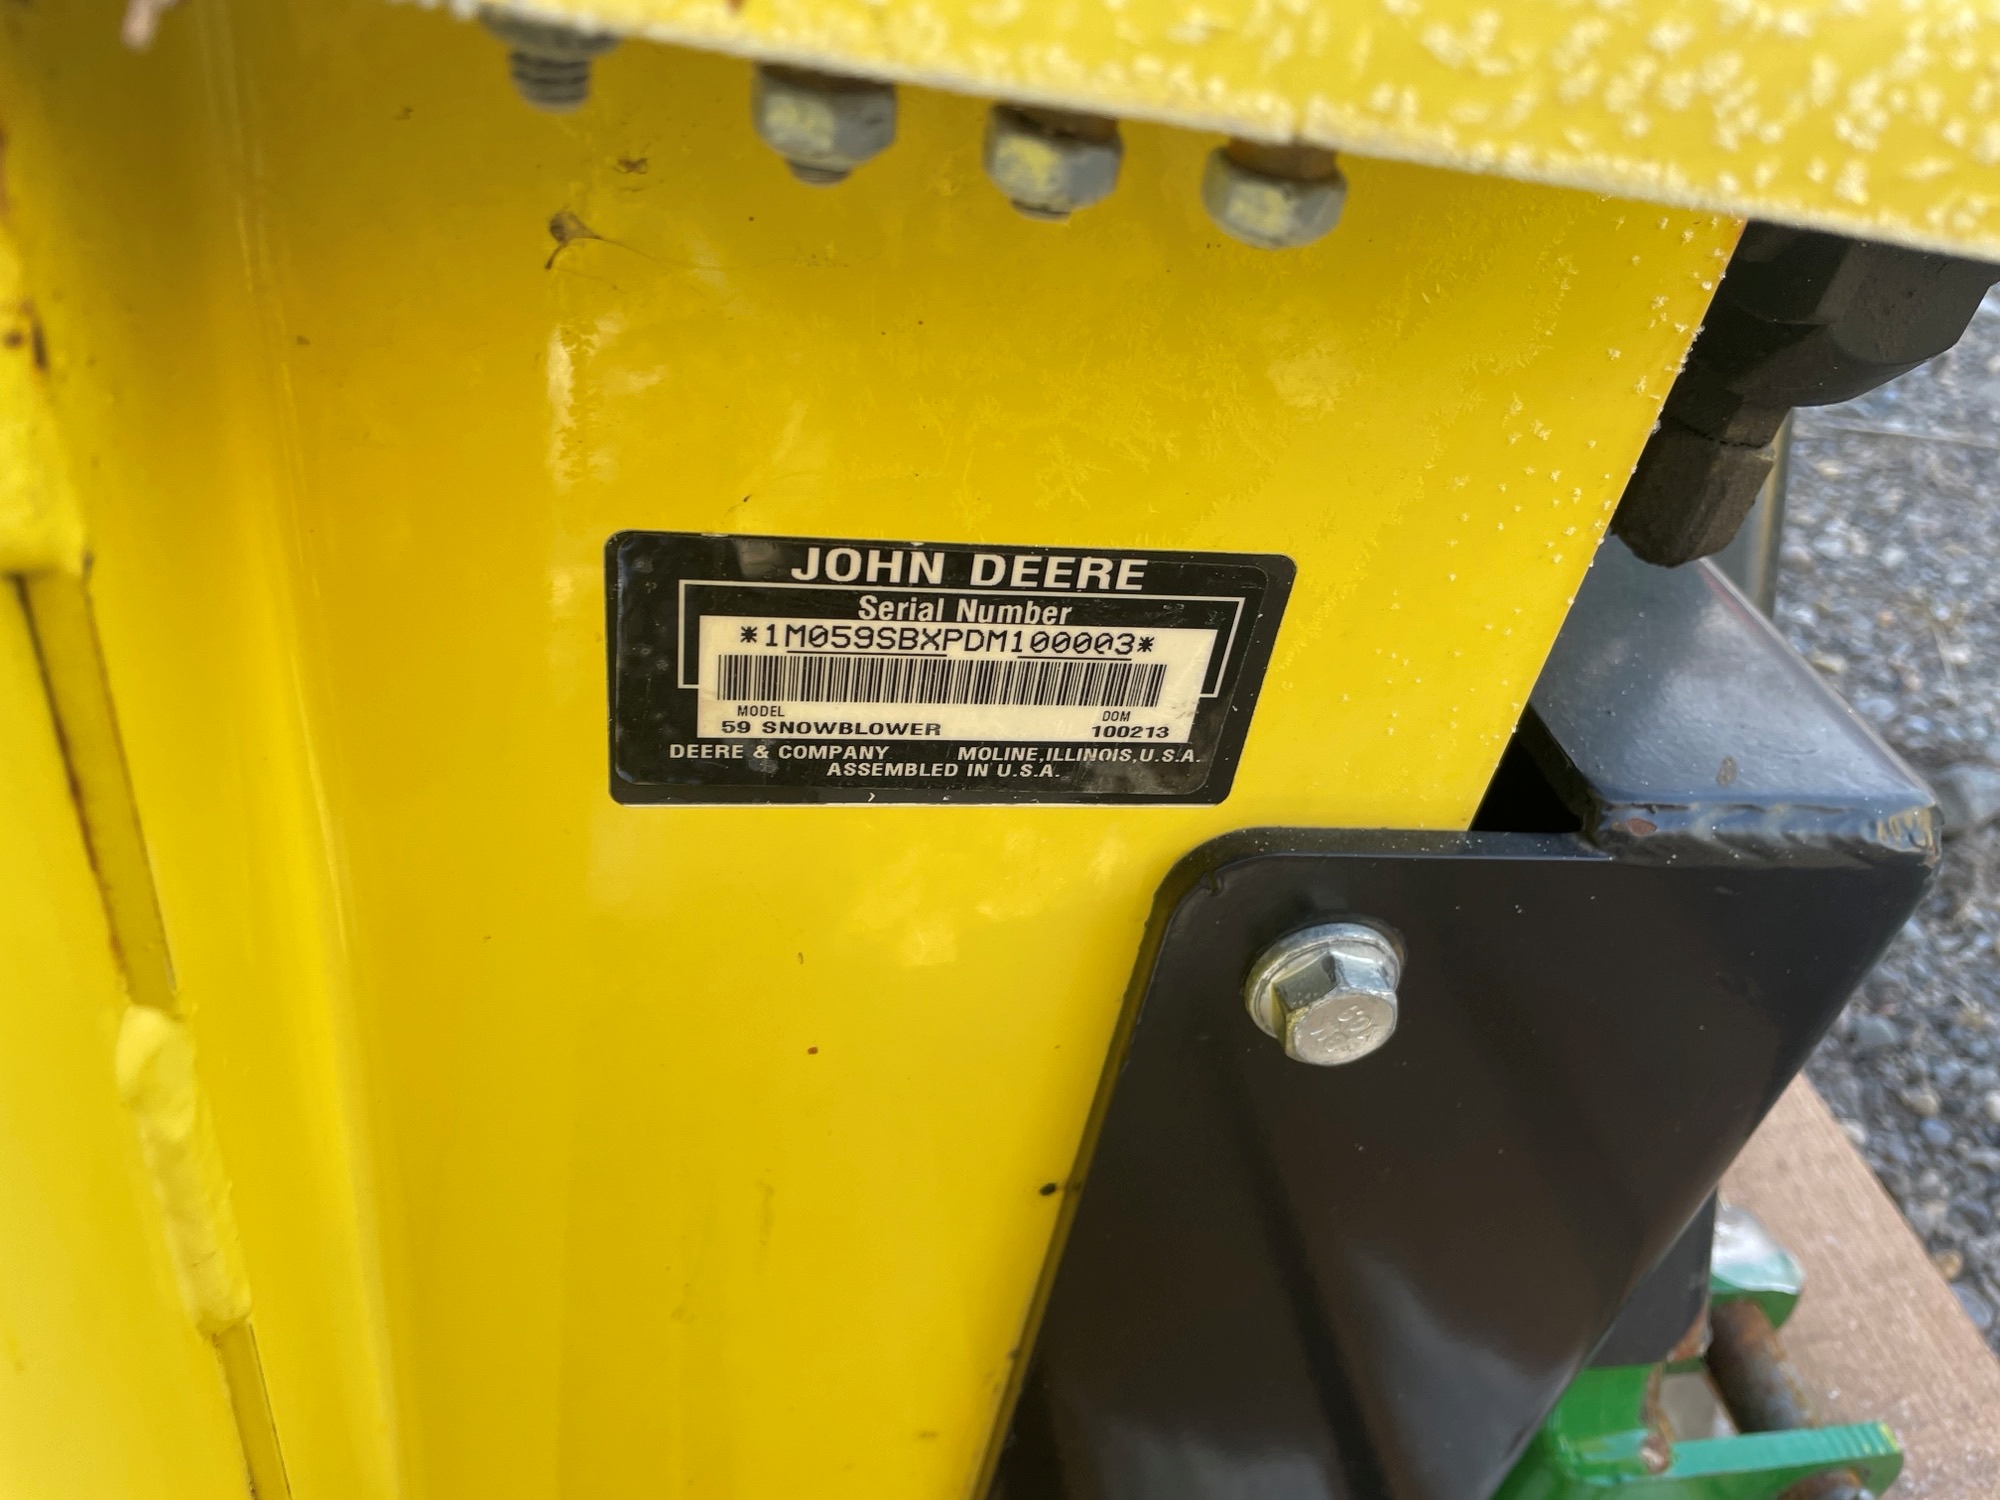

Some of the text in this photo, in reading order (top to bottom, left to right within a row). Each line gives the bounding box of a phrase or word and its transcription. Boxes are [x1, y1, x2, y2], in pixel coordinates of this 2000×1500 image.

[791, 547, 1148, 591] JOHN DEERE
[858, 594, 1072, 626] Serial Number
[737, 704, 785, 718] MODEL
[1102, 710, 1131, 723] DOM
[721, 720, 941, 737] 59 SNOWBLOWER
[1091, 724, 1170, 739] 100213
[669, 743, 890, 760] DEERE & COMPANY
[826, 762, 1060, 778] ASSEMBLED IN U.S.A.
